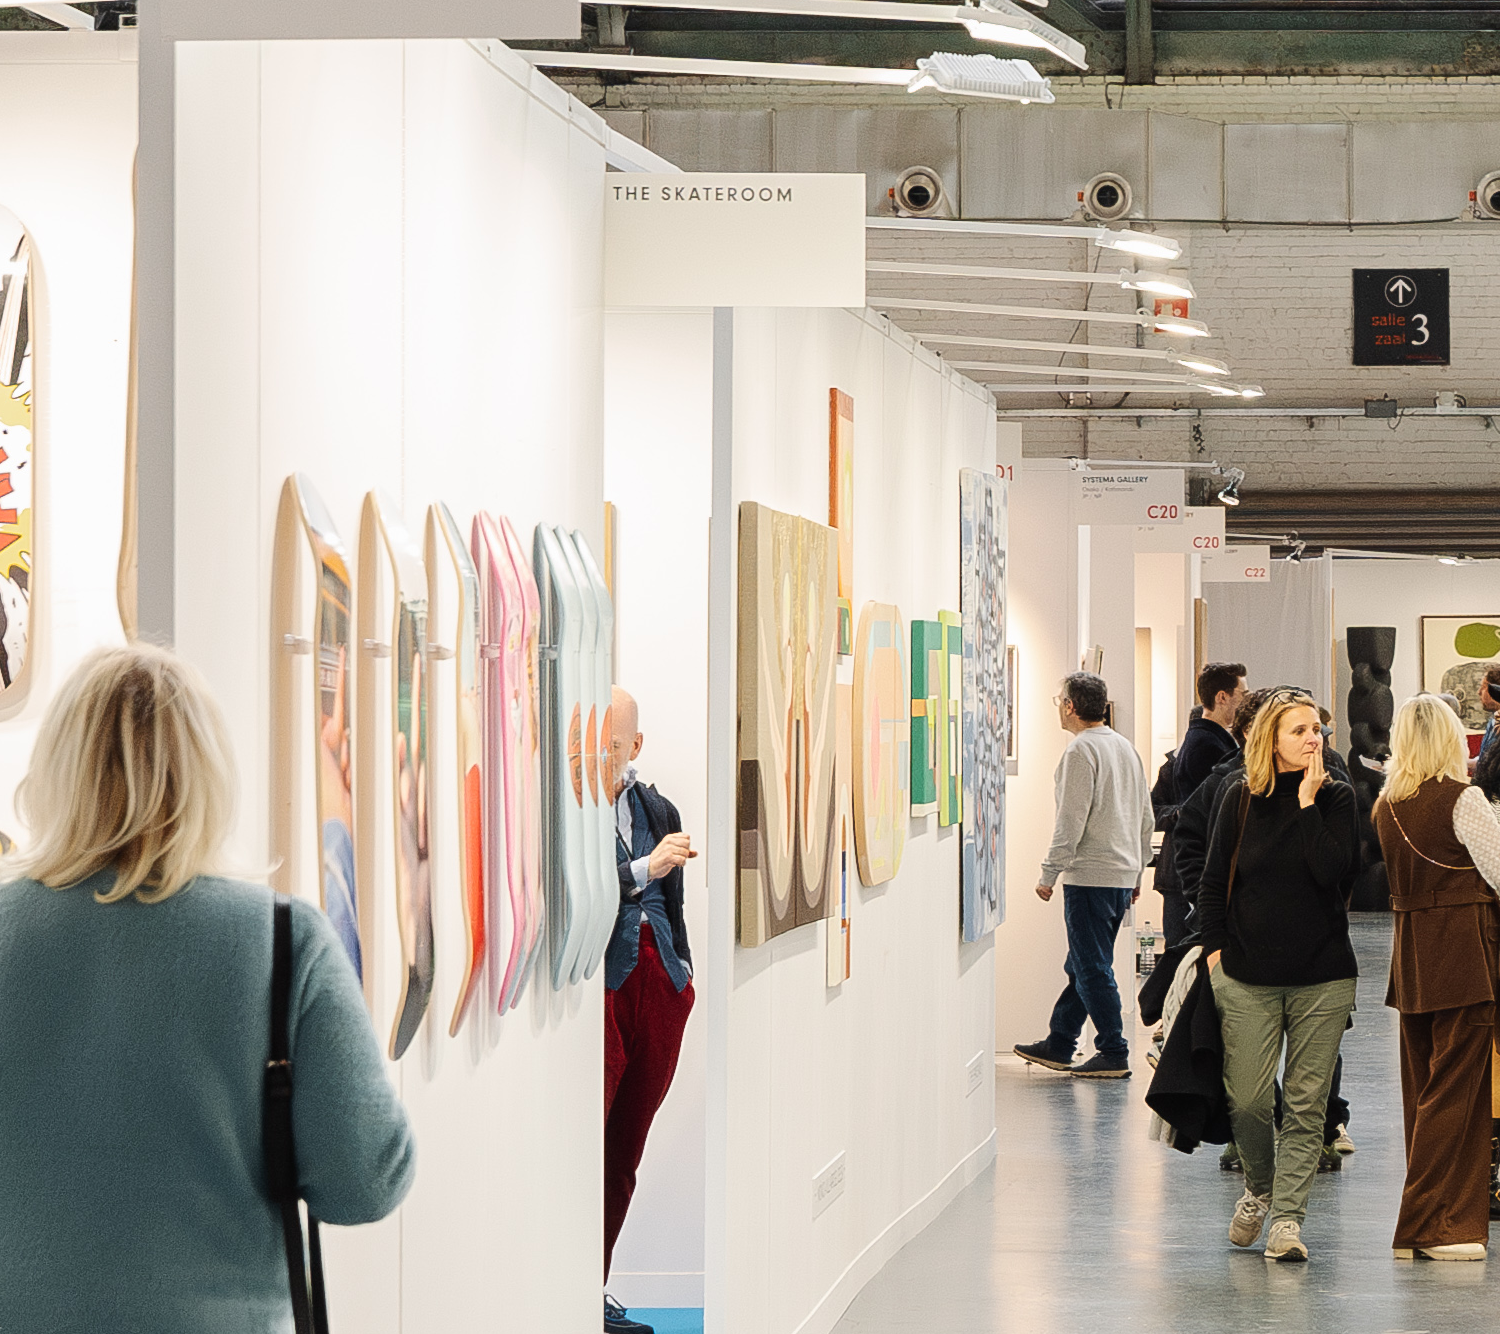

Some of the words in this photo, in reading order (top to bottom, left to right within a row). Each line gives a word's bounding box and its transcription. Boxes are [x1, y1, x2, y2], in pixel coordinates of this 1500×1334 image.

[612, 186, 650, 201] THE
[661, 186, 793, 202] SKATEROOM
[1371, 312, 1406, 327] salle
[1411, 313, 1430, 346] 3
[1147, 505, 1178, 519] C20
[1193, 536, 1219, 549] C20
[1245, 567, 1266, 578] C22
